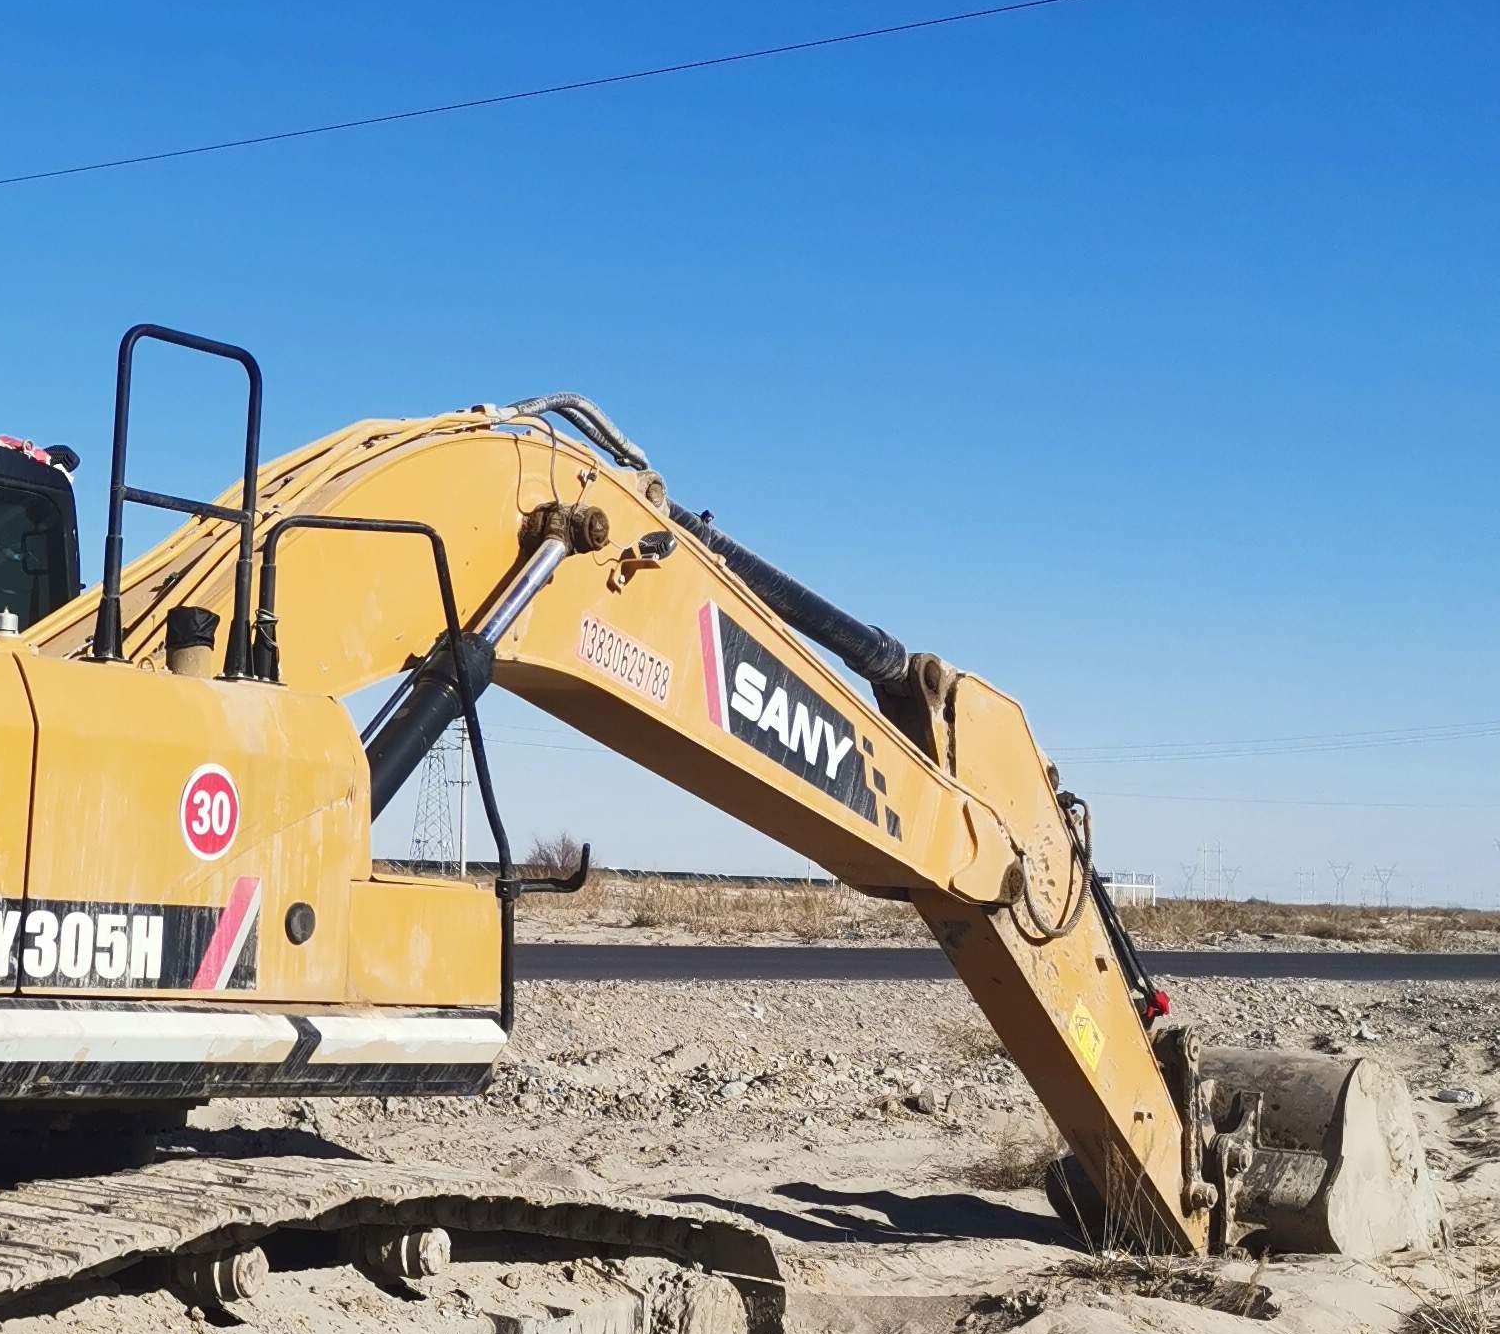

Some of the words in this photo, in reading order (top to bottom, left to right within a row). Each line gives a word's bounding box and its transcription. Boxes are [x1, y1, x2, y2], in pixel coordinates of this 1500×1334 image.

[580, 619, 670, 701] 13830629788
[730, 661, 854, 780] SANY
[191, 789, 231, 836] 30
